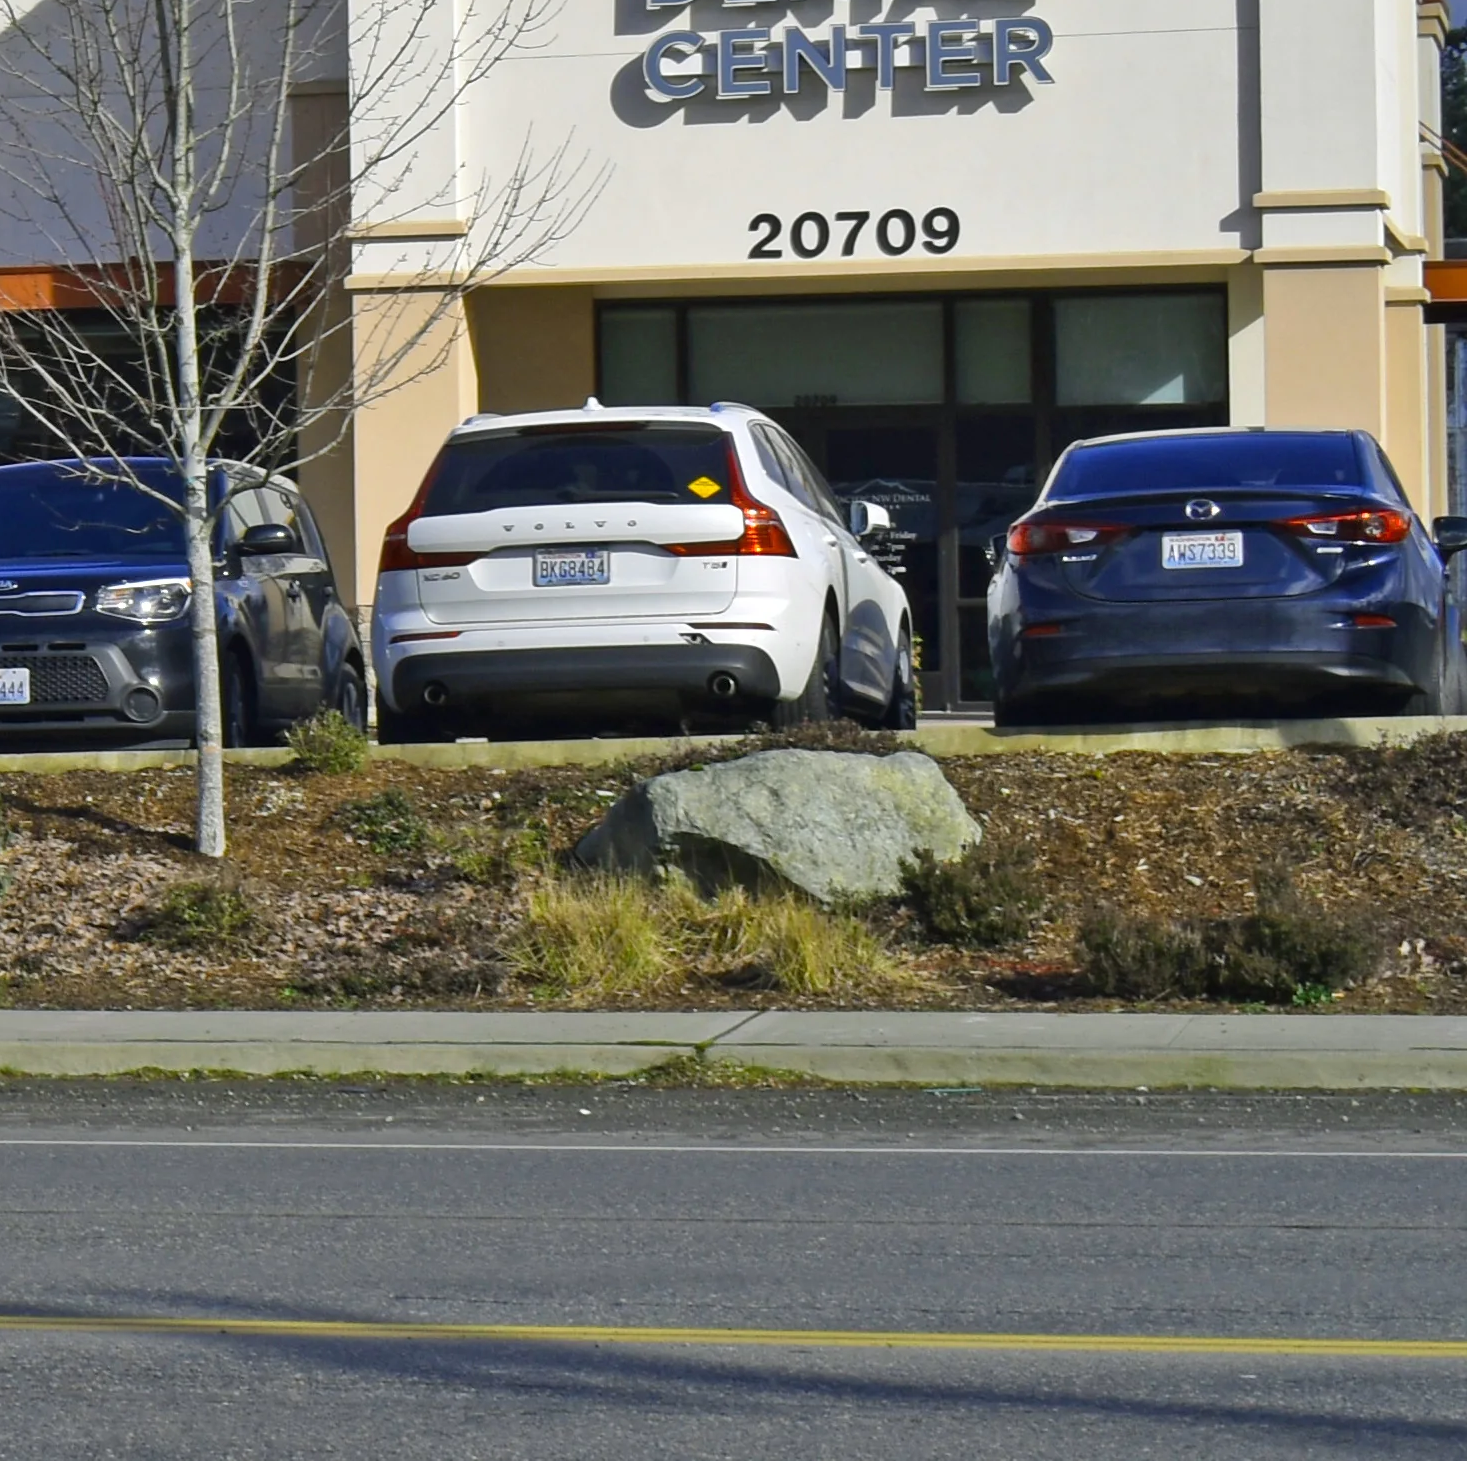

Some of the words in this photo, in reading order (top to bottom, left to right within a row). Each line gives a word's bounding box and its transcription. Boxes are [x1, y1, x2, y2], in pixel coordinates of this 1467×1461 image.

[642, 15, 1055, 101] CENTER
[747, 206, 961, 260] 20709
[892, 493, 931, 503] DENTAL
[502, 520, 637, 532] VOLVO
[1167, 542, 1236, 562] AWS7339
[540, 559, 605, 579] BKG8484
